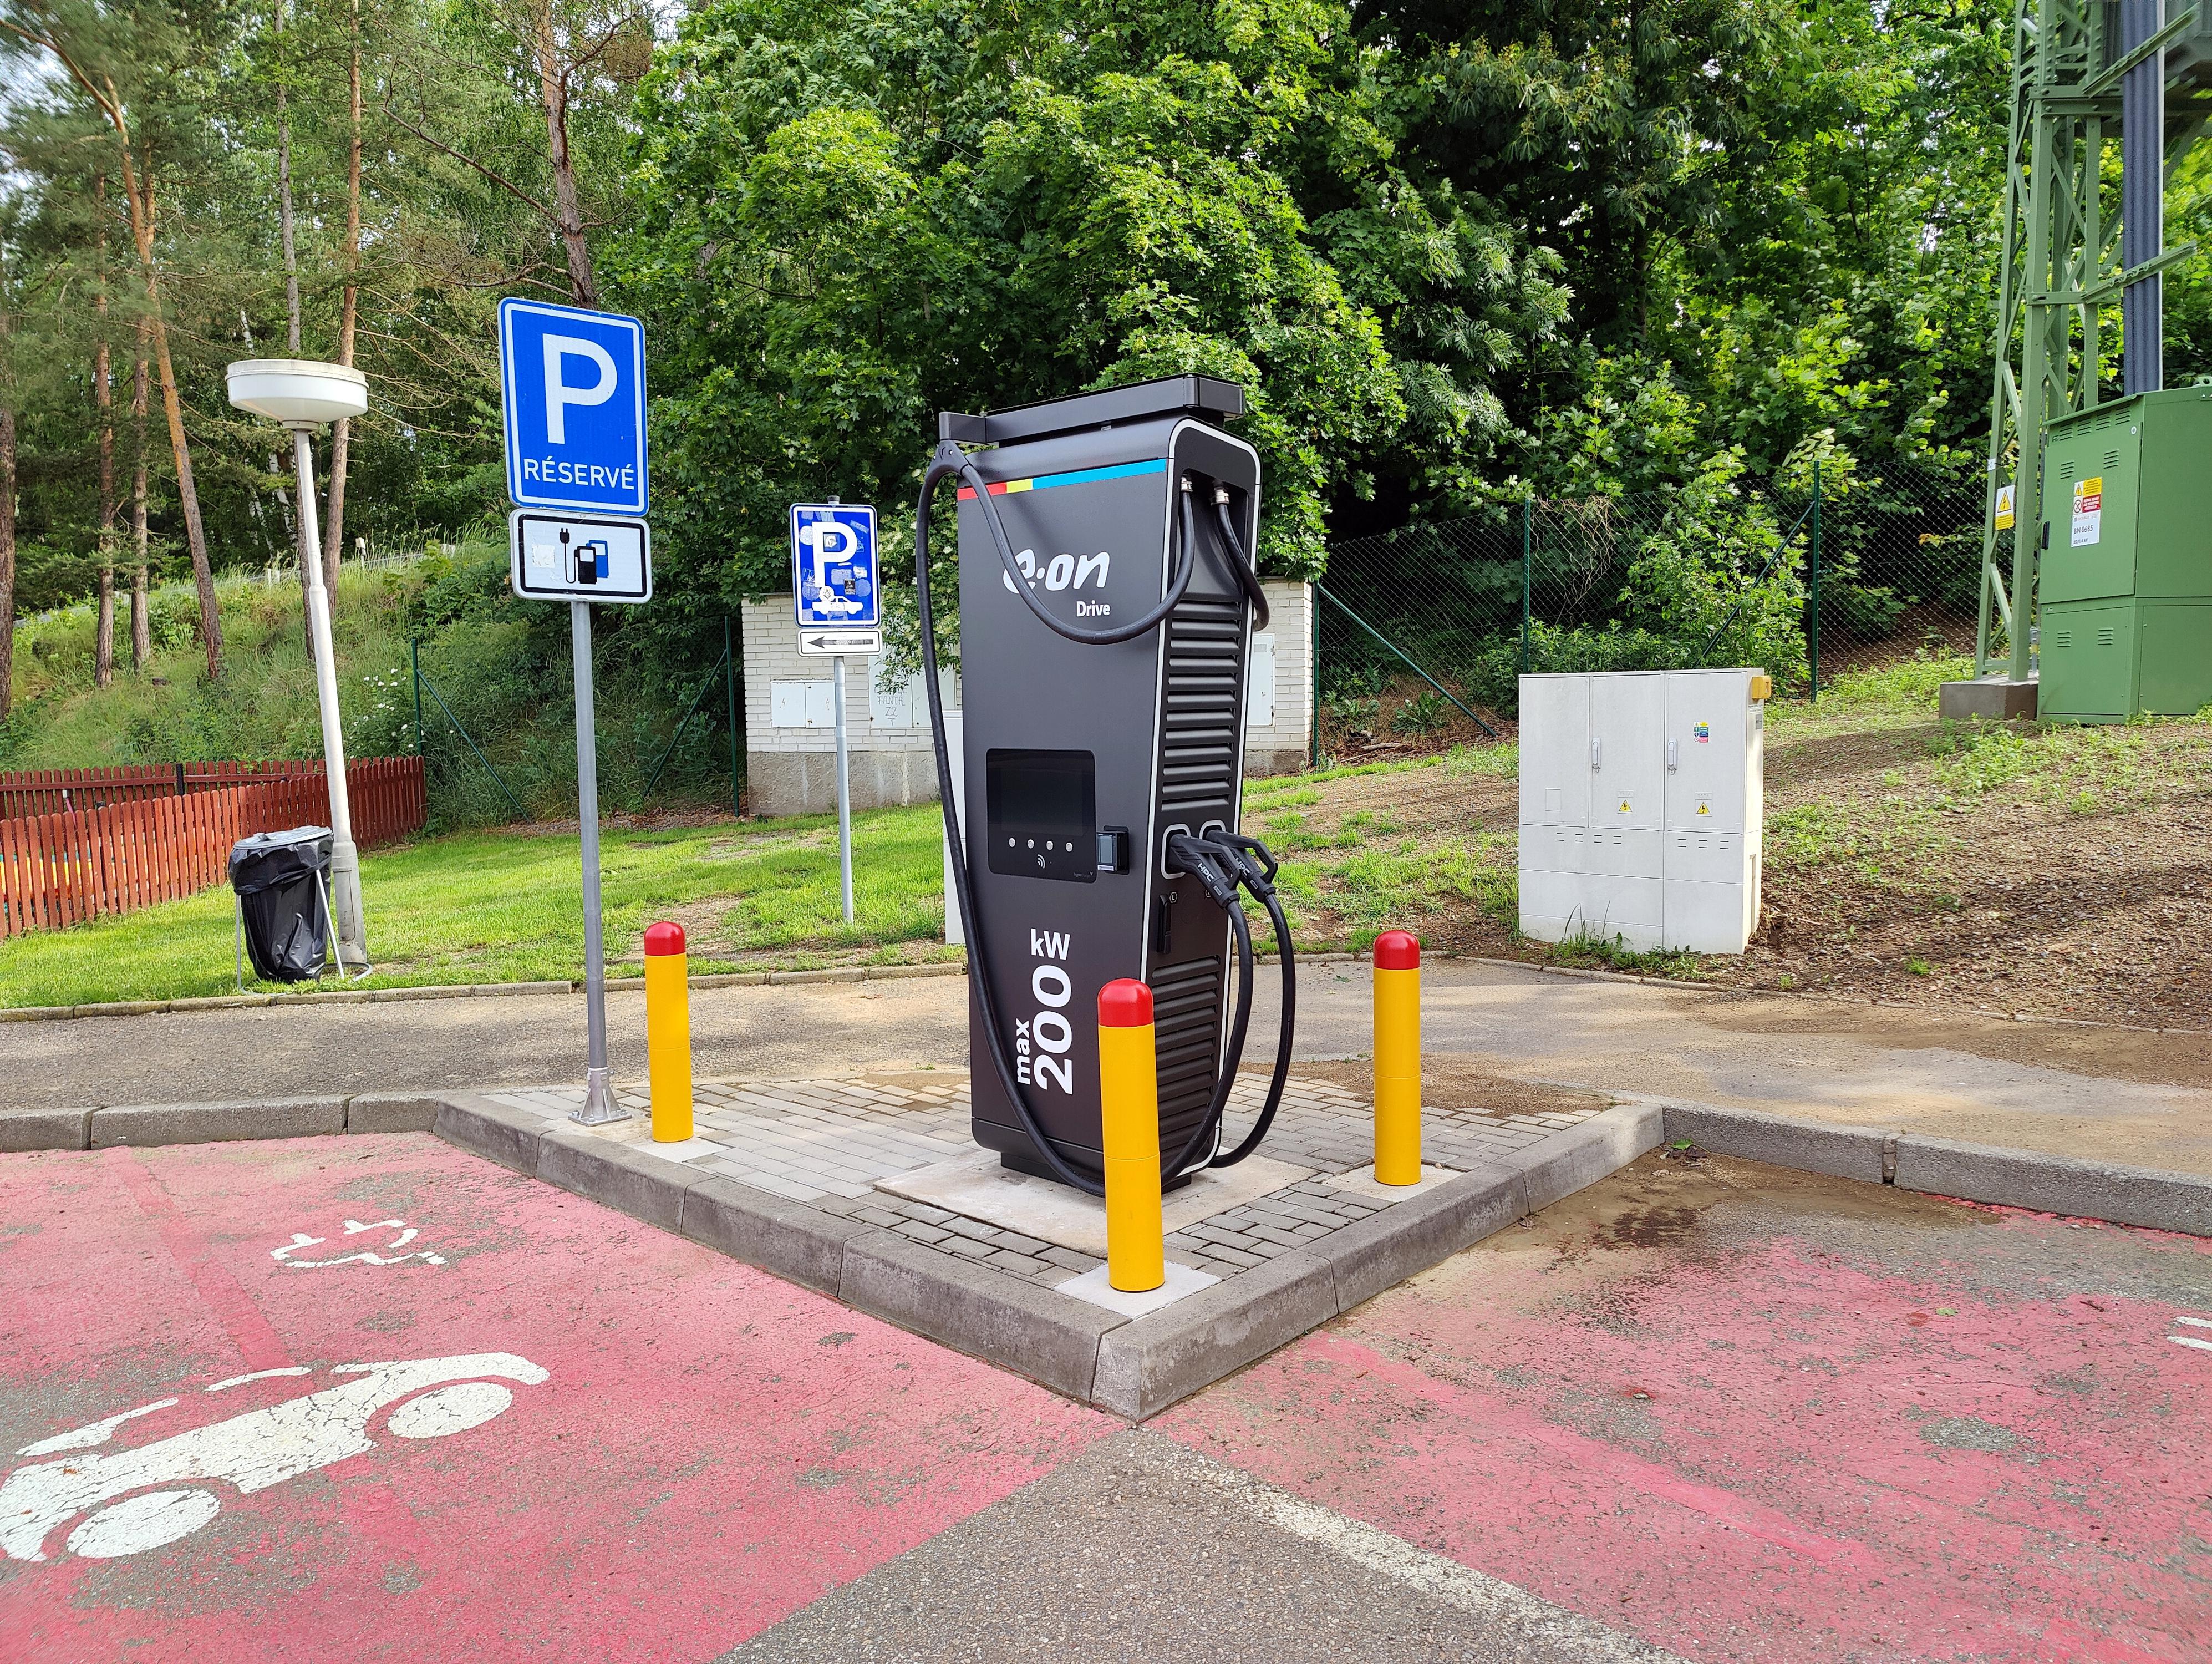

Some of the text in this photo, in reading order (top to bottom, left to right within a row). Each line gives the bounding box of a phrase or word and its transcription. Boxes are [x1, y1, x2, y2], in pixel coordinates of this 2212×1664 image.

[542, 333, 617, 444] P
[524, 455, 635, 490] RÉSERVÉ
[812, 521, 858, 588] P
[1076, 600, 1111, 617] Drive
[1197, 862, 1214, 882] HPC
[1031, 928, 1071, 961] kW
[1016, 1018, 1030, 1085] max
[1032, 964, 1073, 1095] 200
